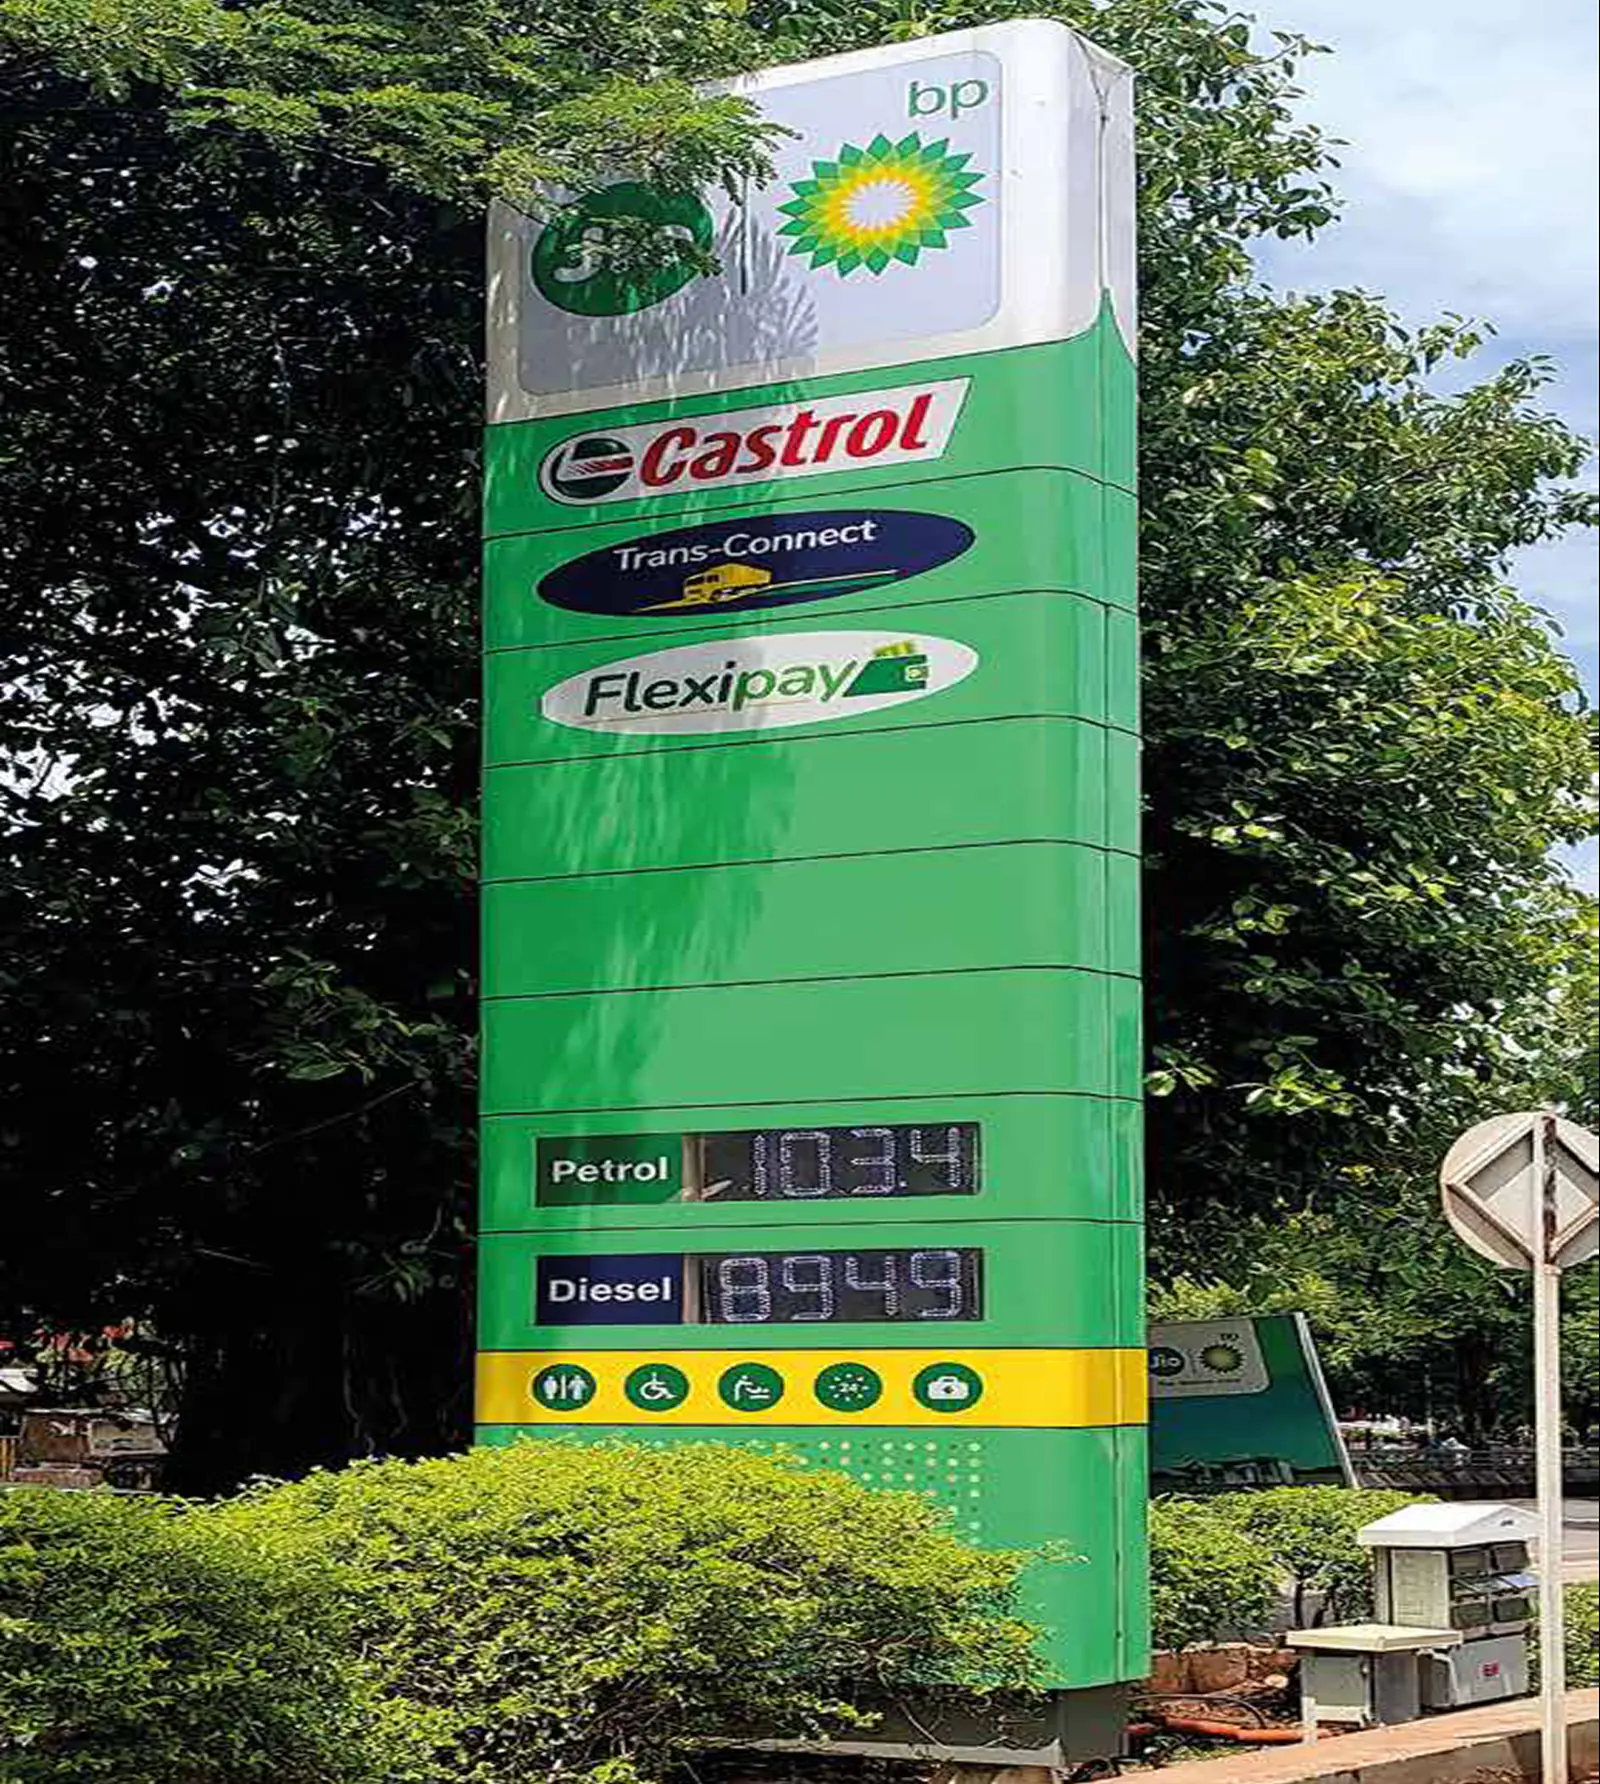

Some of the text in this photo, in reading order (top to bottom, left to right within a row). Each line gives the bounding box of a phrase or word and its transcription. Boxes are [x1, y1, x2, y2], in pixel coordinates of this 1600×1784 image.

[909, 80, 989, 120] bp
[640, 393, 932, 487] Castrol
[613, 520, 877, 571] Trans-Connect
[584, 661, 857, 716] Flexipay
[552, 1156, 668, 1183] Petrol
[549, 1276, 671, 1302] Diesel
